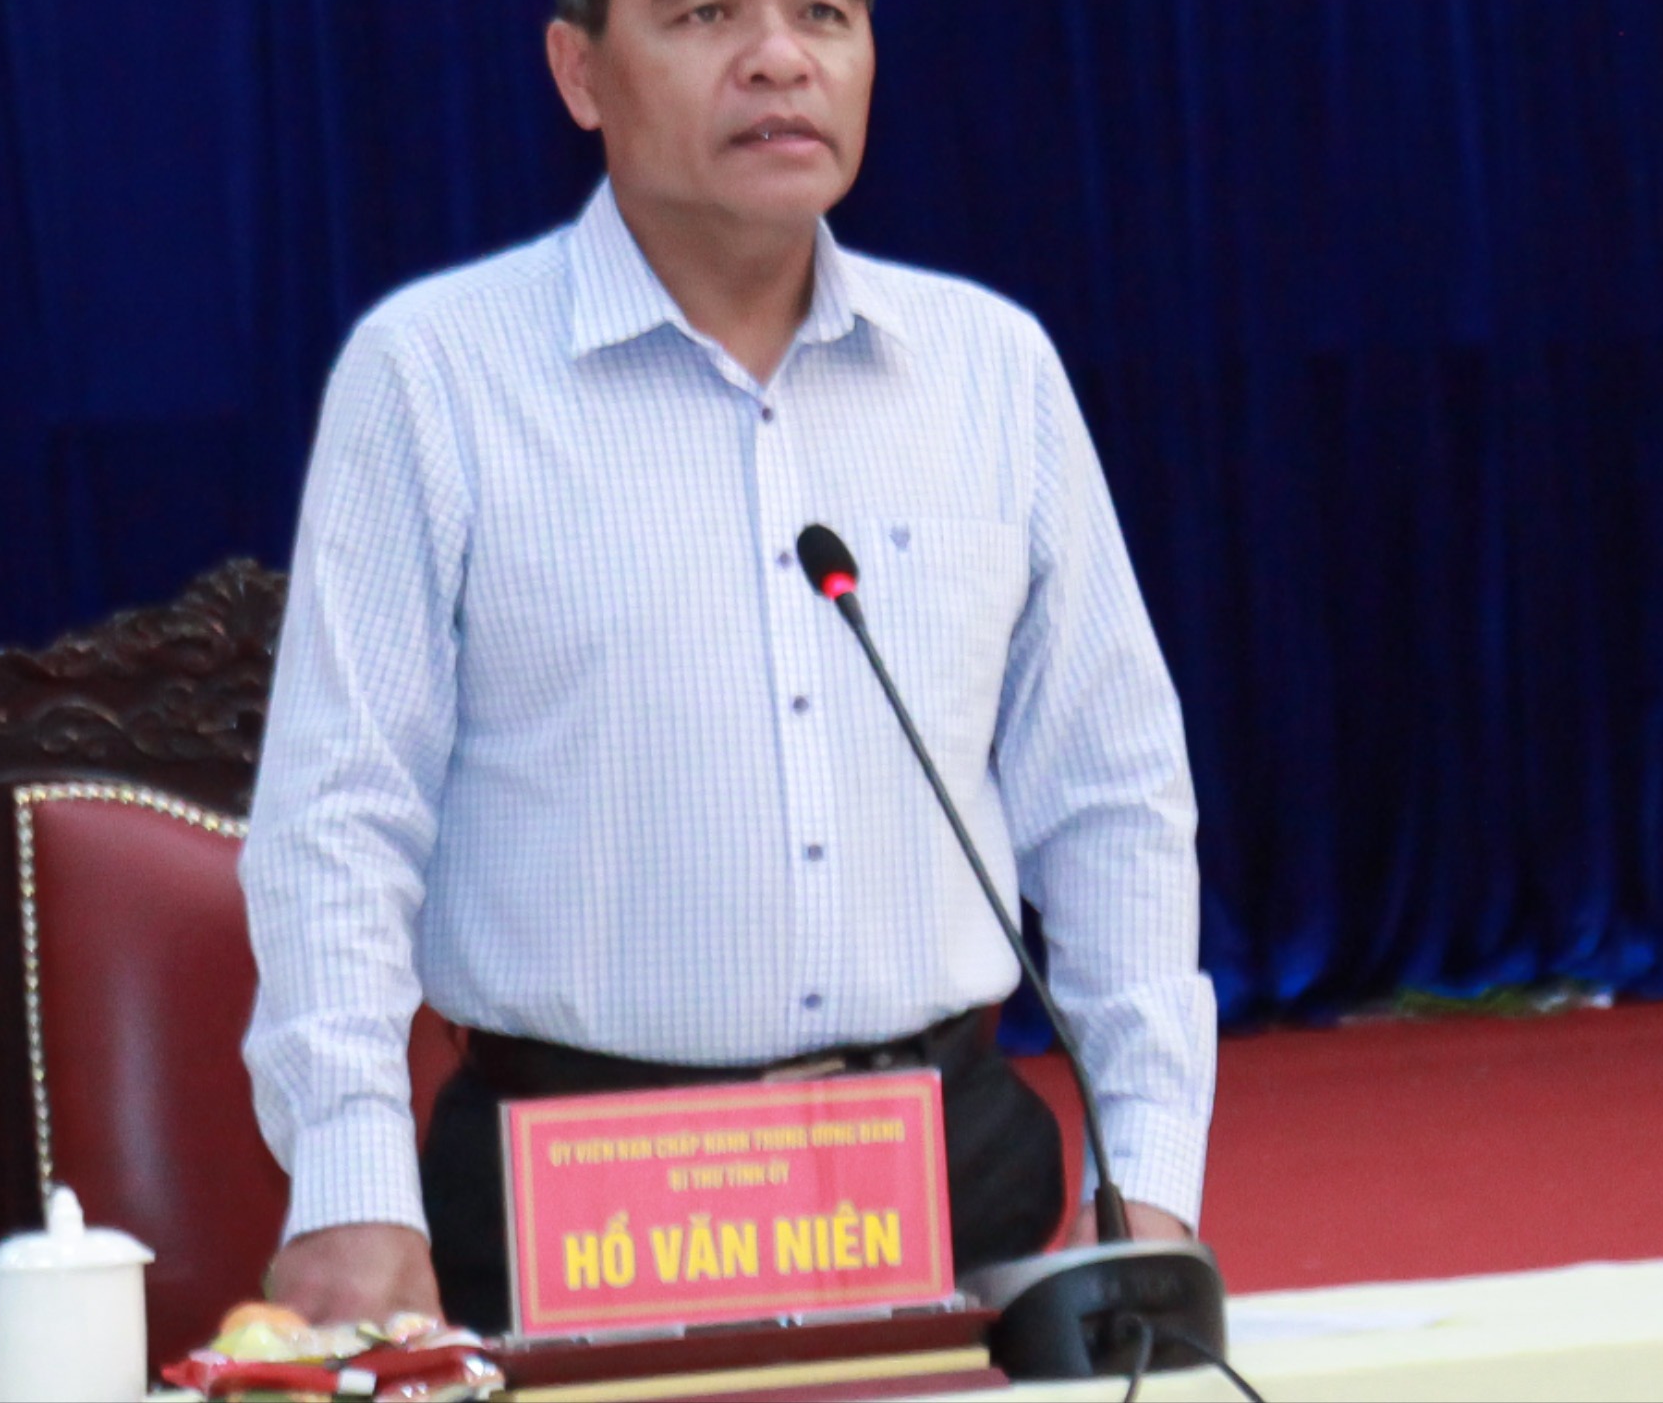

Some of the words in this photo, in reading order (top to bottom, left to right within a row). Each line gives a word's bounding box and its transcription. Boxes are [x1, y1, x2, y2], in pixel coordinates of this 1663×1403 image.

[564, 1211, 635, 1290] HỒ
[651, 1213, 759, 1283] VĂN
[773, 1200, 902, 1275] NIÊN
